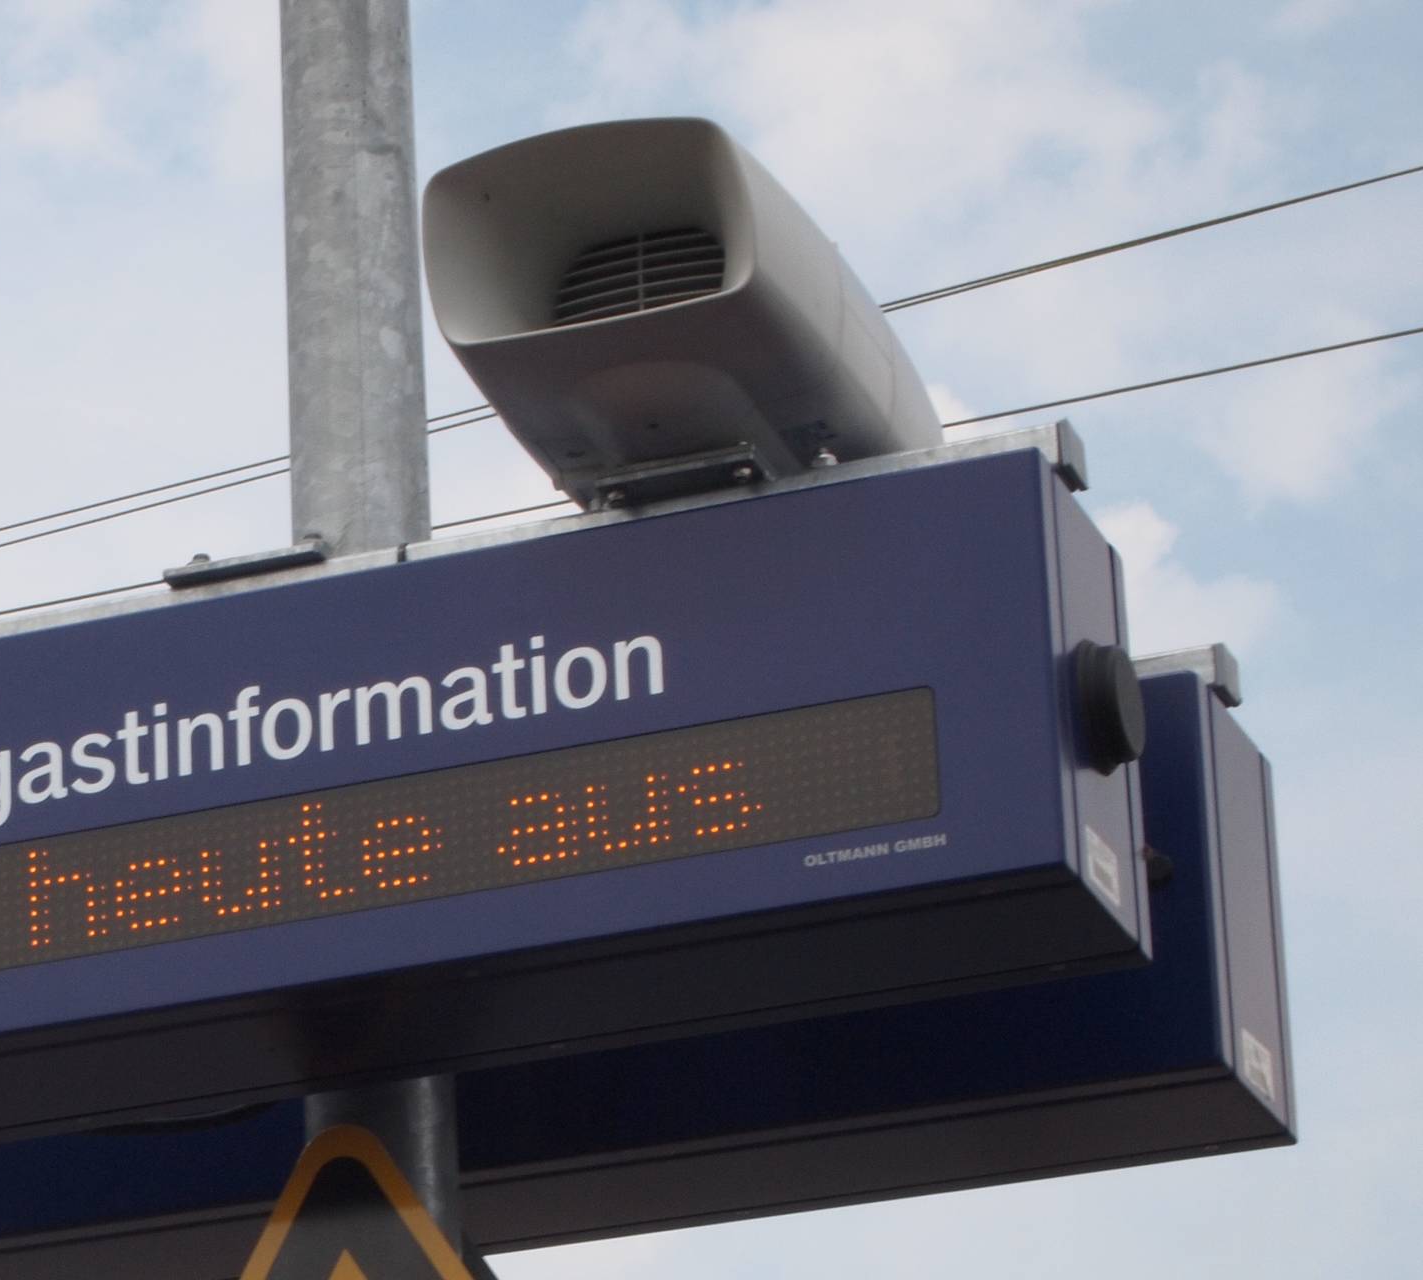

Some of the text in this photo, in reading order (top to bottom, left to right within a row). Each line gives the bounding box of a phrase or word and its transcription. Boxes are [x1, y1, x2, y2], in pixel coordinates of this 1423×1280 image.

[25, 801, 444, 950] heute
[496, 759, 763, 868] aus
[804, 833, 947, 867] OLTMANN GMBH
